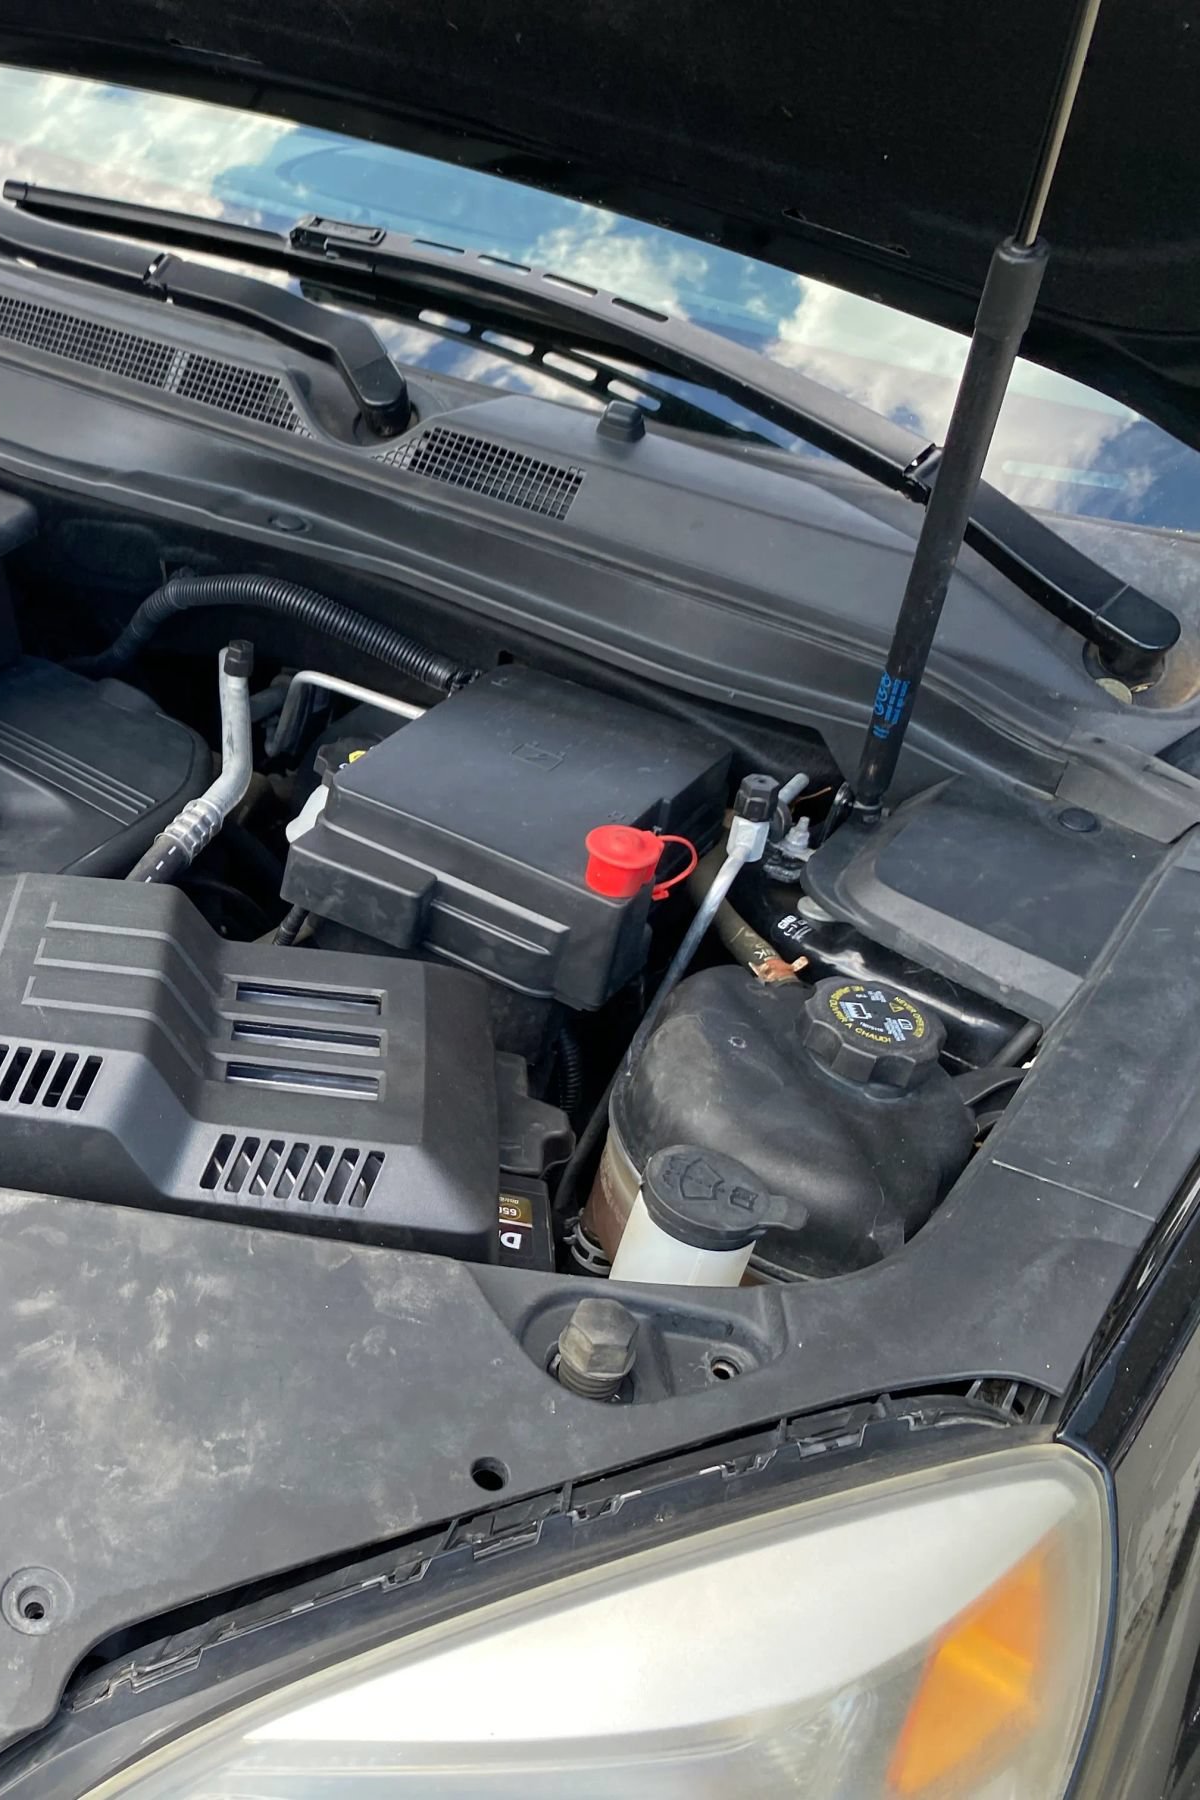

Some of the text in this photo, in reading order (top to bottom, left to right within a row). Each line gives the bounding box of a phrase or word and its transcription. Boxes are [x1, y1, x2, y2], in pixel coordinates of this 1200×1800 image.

[894, 996, 917, 1013] NEVER
[855, 1027, 892, 1045] CHAUD!
[499, 1229, 522, 1250] D
